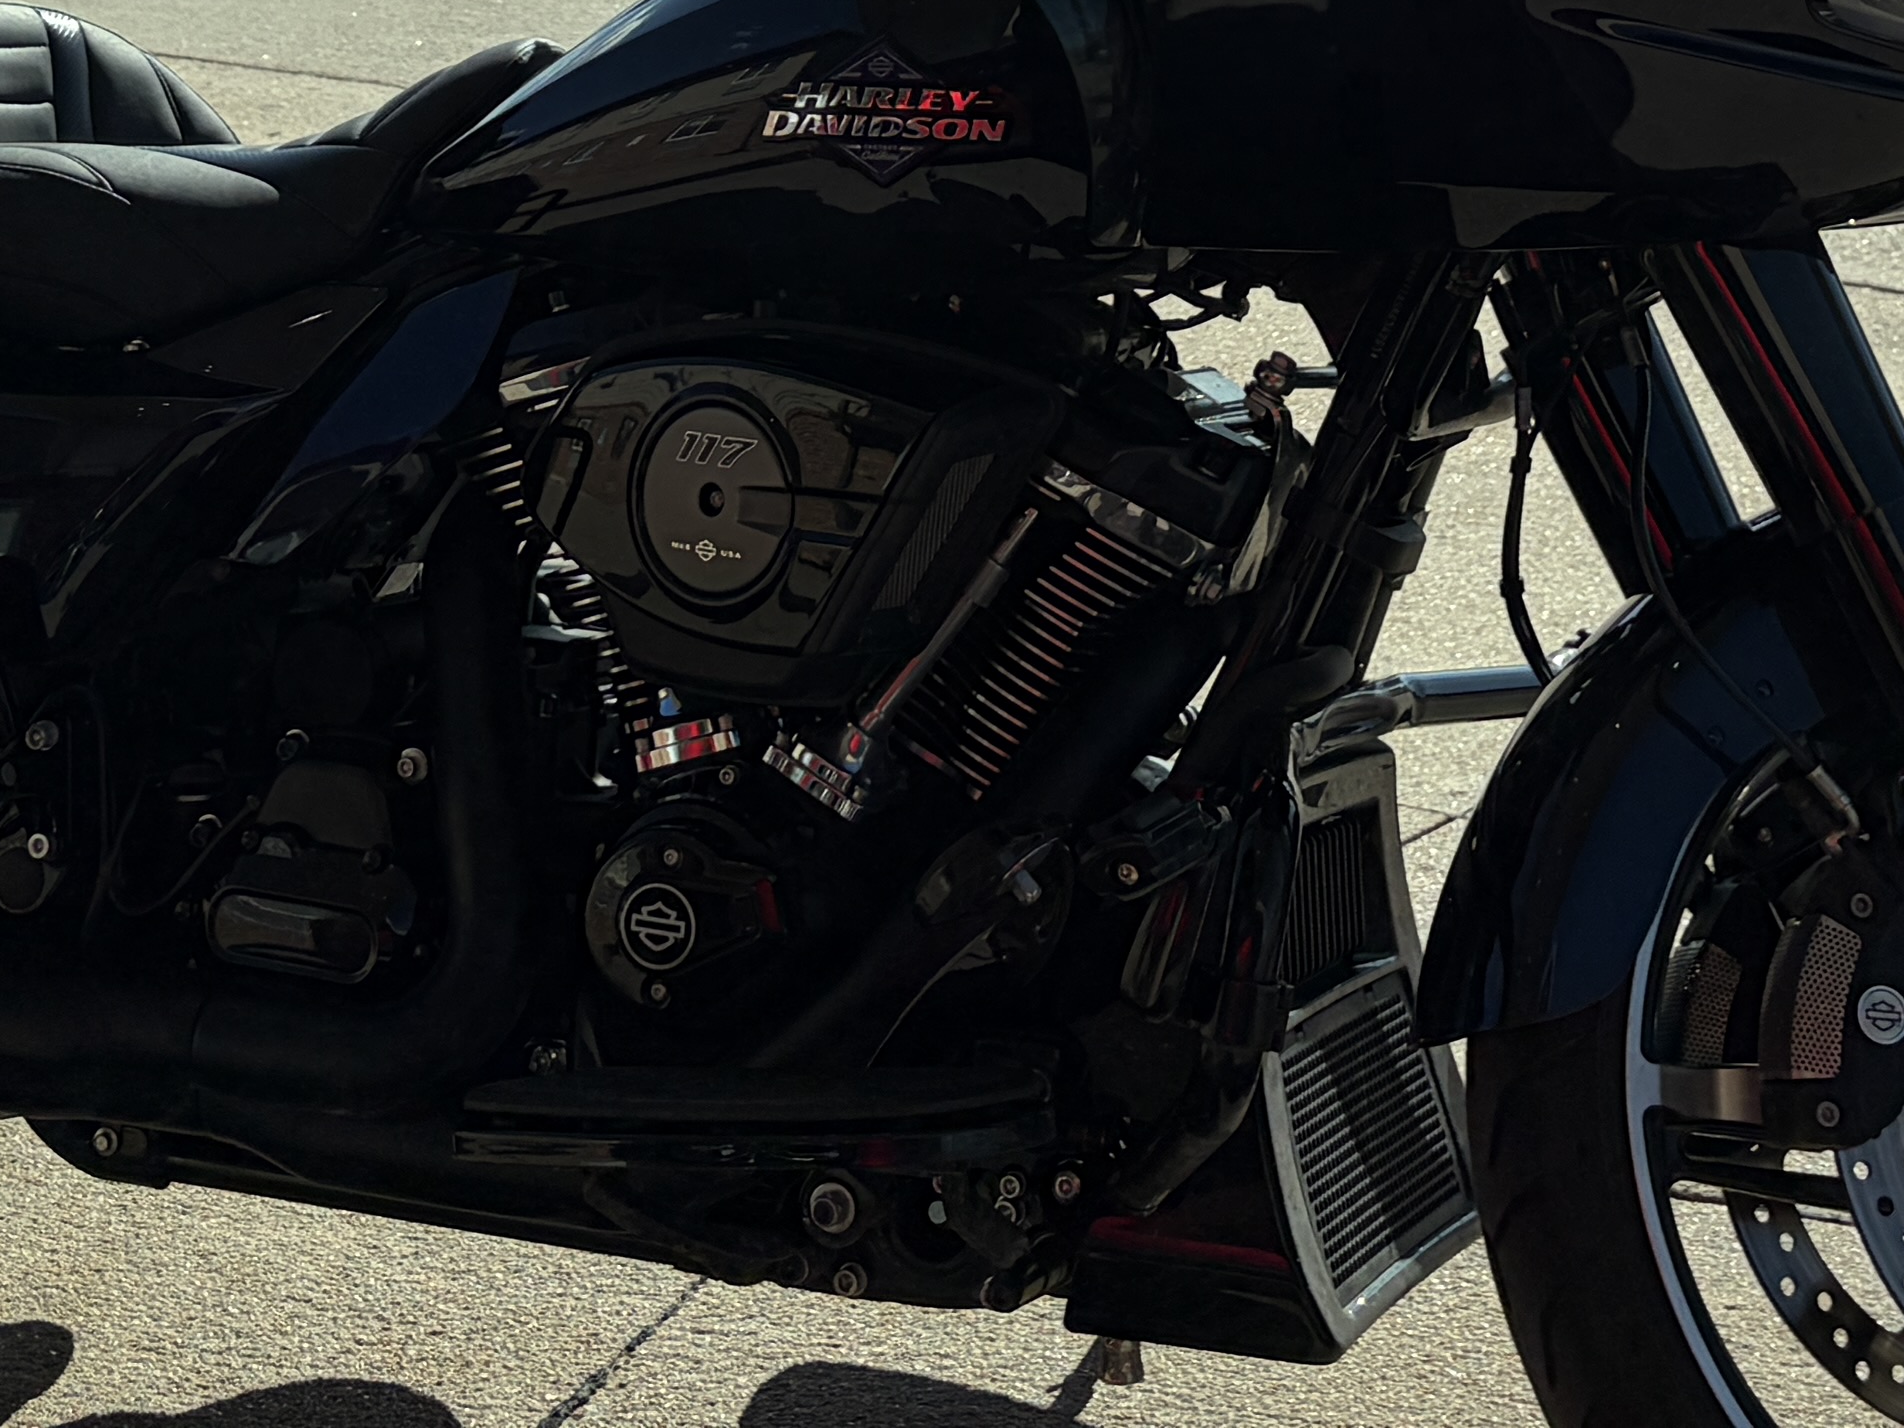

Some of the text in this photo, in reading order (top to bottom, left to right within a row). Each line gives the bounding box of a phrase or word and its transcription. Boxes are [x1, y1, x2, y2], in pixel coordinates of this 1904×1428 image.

[762, 110, 1006, 142] DAVIDSON
[675, 431, 758, 469] 117
[720, 549, 742, 559] USA
